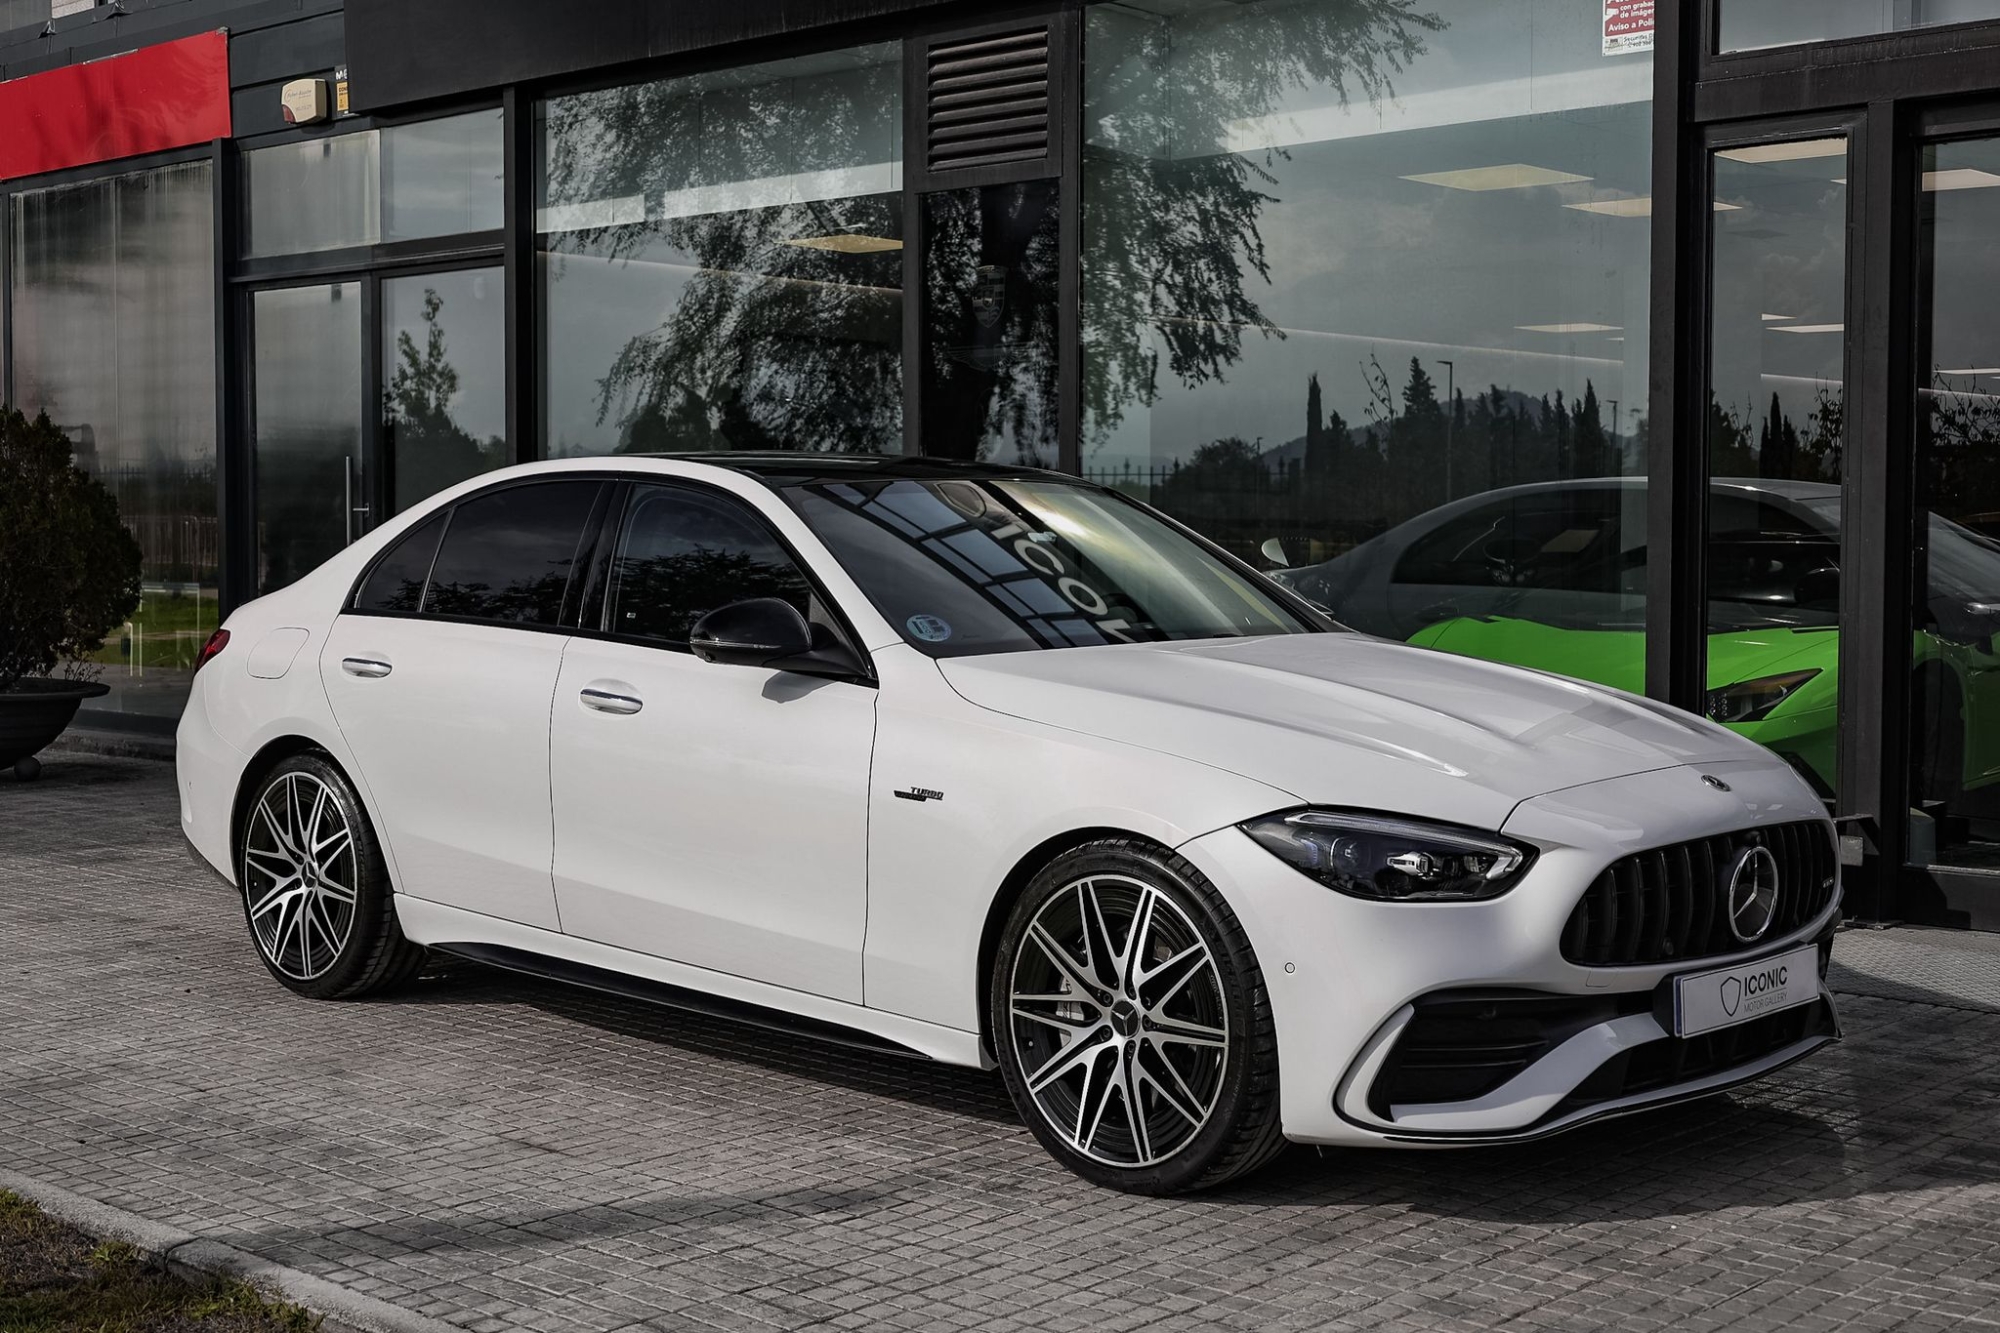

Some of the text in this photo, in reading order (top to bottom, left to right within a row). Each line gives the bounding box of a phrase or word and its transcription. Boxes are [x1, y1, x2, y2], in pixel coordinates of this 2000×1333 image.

[1608, 22, 1629, 31] Aviso
[911, 786, 944, 800] TURBO
[1744, 966, 1787, 996] ICONIC
[1744, 992, 1788, 1012] MOTOR GALLERY
